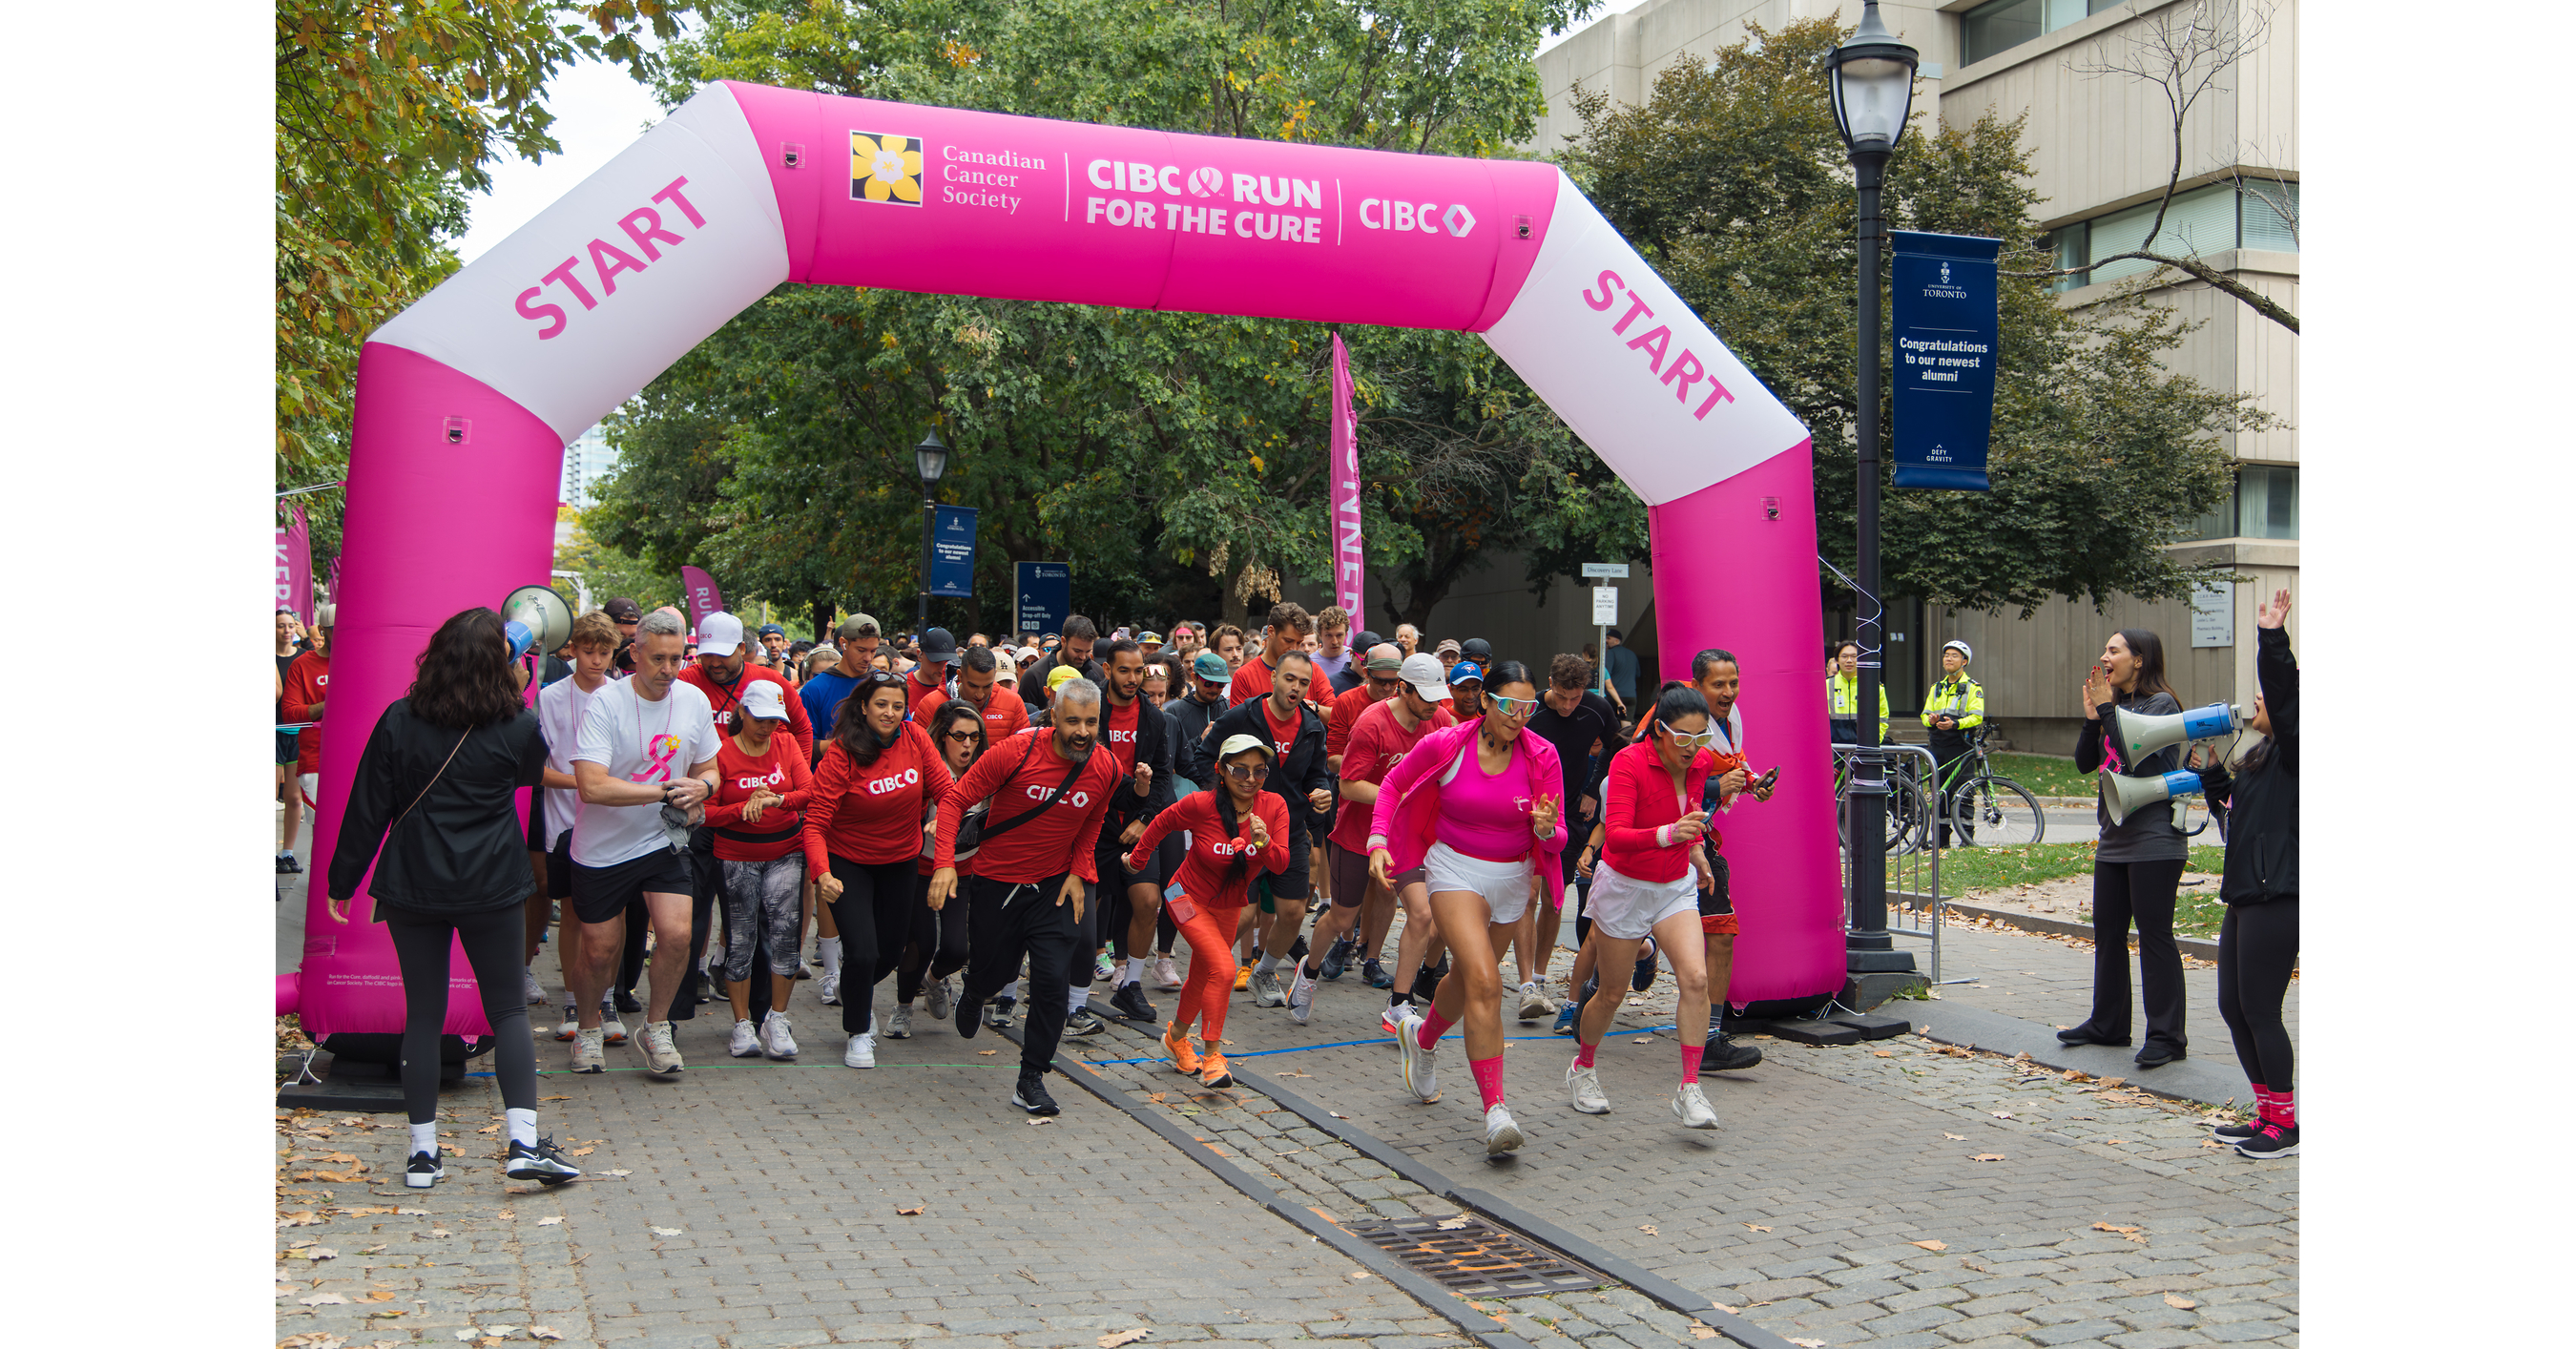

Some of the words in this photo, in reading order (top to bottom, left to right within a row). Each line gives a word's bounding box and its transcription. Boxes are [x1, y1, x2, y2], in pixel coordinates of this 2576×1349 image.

[943, 145, 1047, 171] Canadian
[943, 164, 1019, 188] Cancer
[1088, 158, 1182, 197] CIBC
[1232, 173, 1322, 210] RUN
[943, 185, 1022, 216] Society
[1087, 197, 1156, 230] FOR
[1163, 203, 1228, 236] THE
[1234, 211, 1322, 244] CURE
[1359, 197, 1439, 234] CIBC
[514, 175, 707, 341] START
[1922, 289, 1967, 300] TORONTO
[1582, 269, 1735, 422] START
[1900, 337, 1988, 354] Congratulations
[1904, 353, 1916, 364] to
[1918, 355, 1936, 366] our
[1938, 356, 1981, 368] newest
[1922, 369, 1959, 382] alumni
[936, 543, 972, 551] Congratulations
[1109, 729, 1131, 742] IBC
[738, 776, 768, 789] CIBC
[869, 773, 906, 796] CIBC
[1213, 842, 1235, 856] CIB
